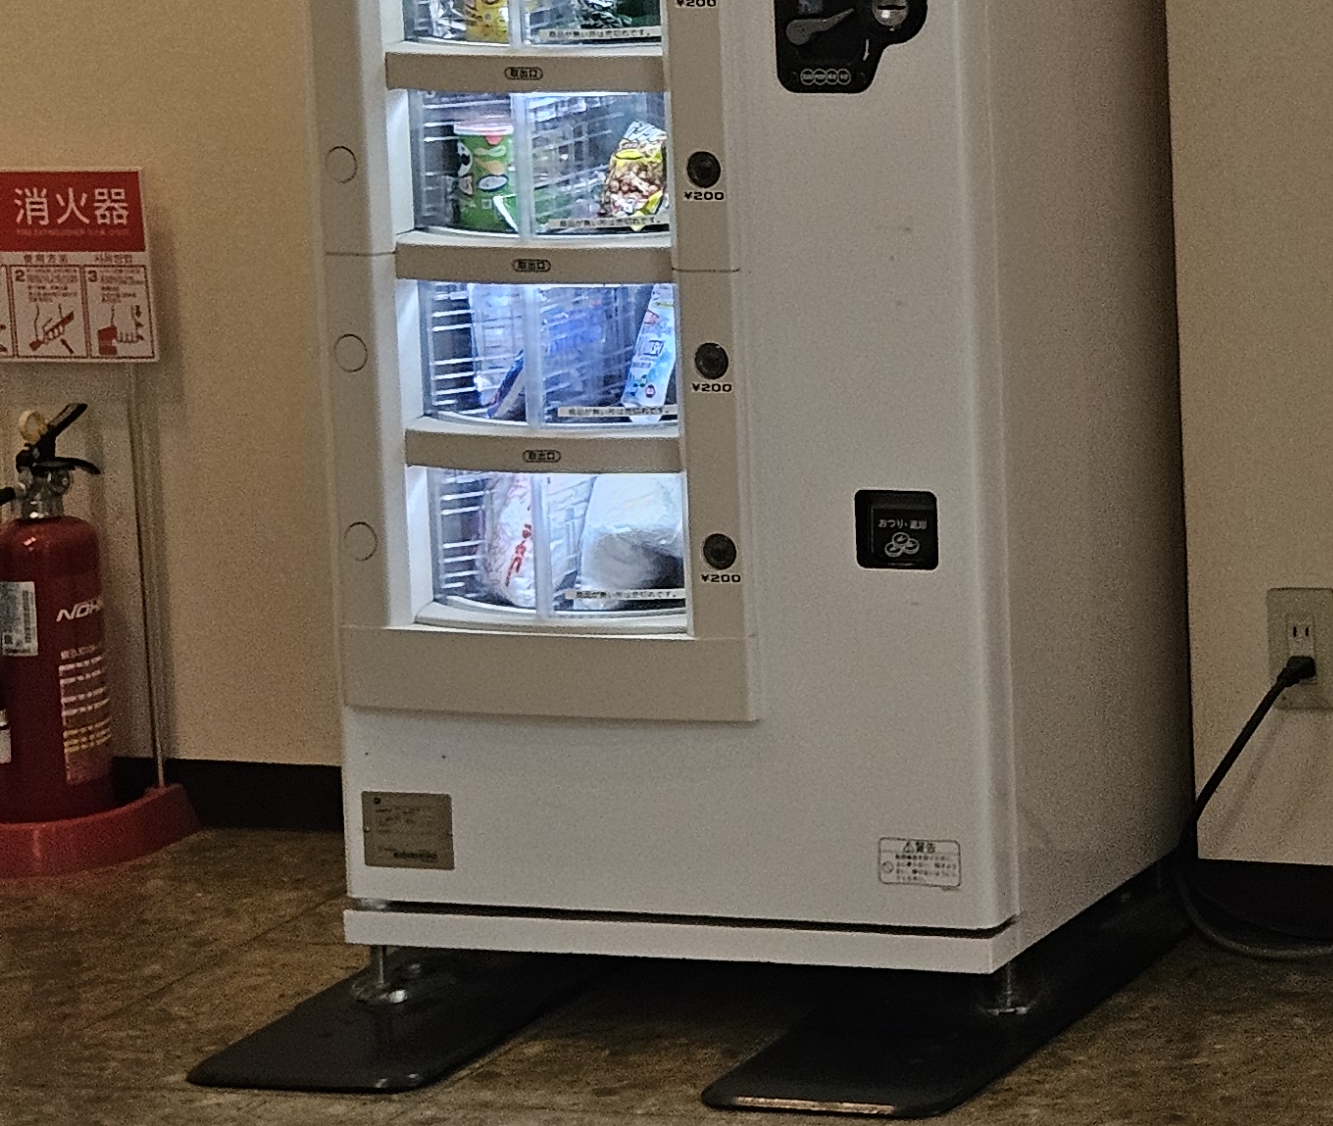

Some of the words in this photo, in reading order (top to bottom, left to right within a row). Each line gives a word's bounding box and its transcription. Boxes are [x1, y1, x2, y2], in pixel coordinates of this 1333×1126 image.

[683, 191, 724, 201] ¥200
[14, 187, 129, 225] 消火器
[15, 270, 25, 282] 2
[88, 269, 98, 283] 3
[691, 383, 732, 393] ¥200
[701, 574, 741, 584] ¥200
